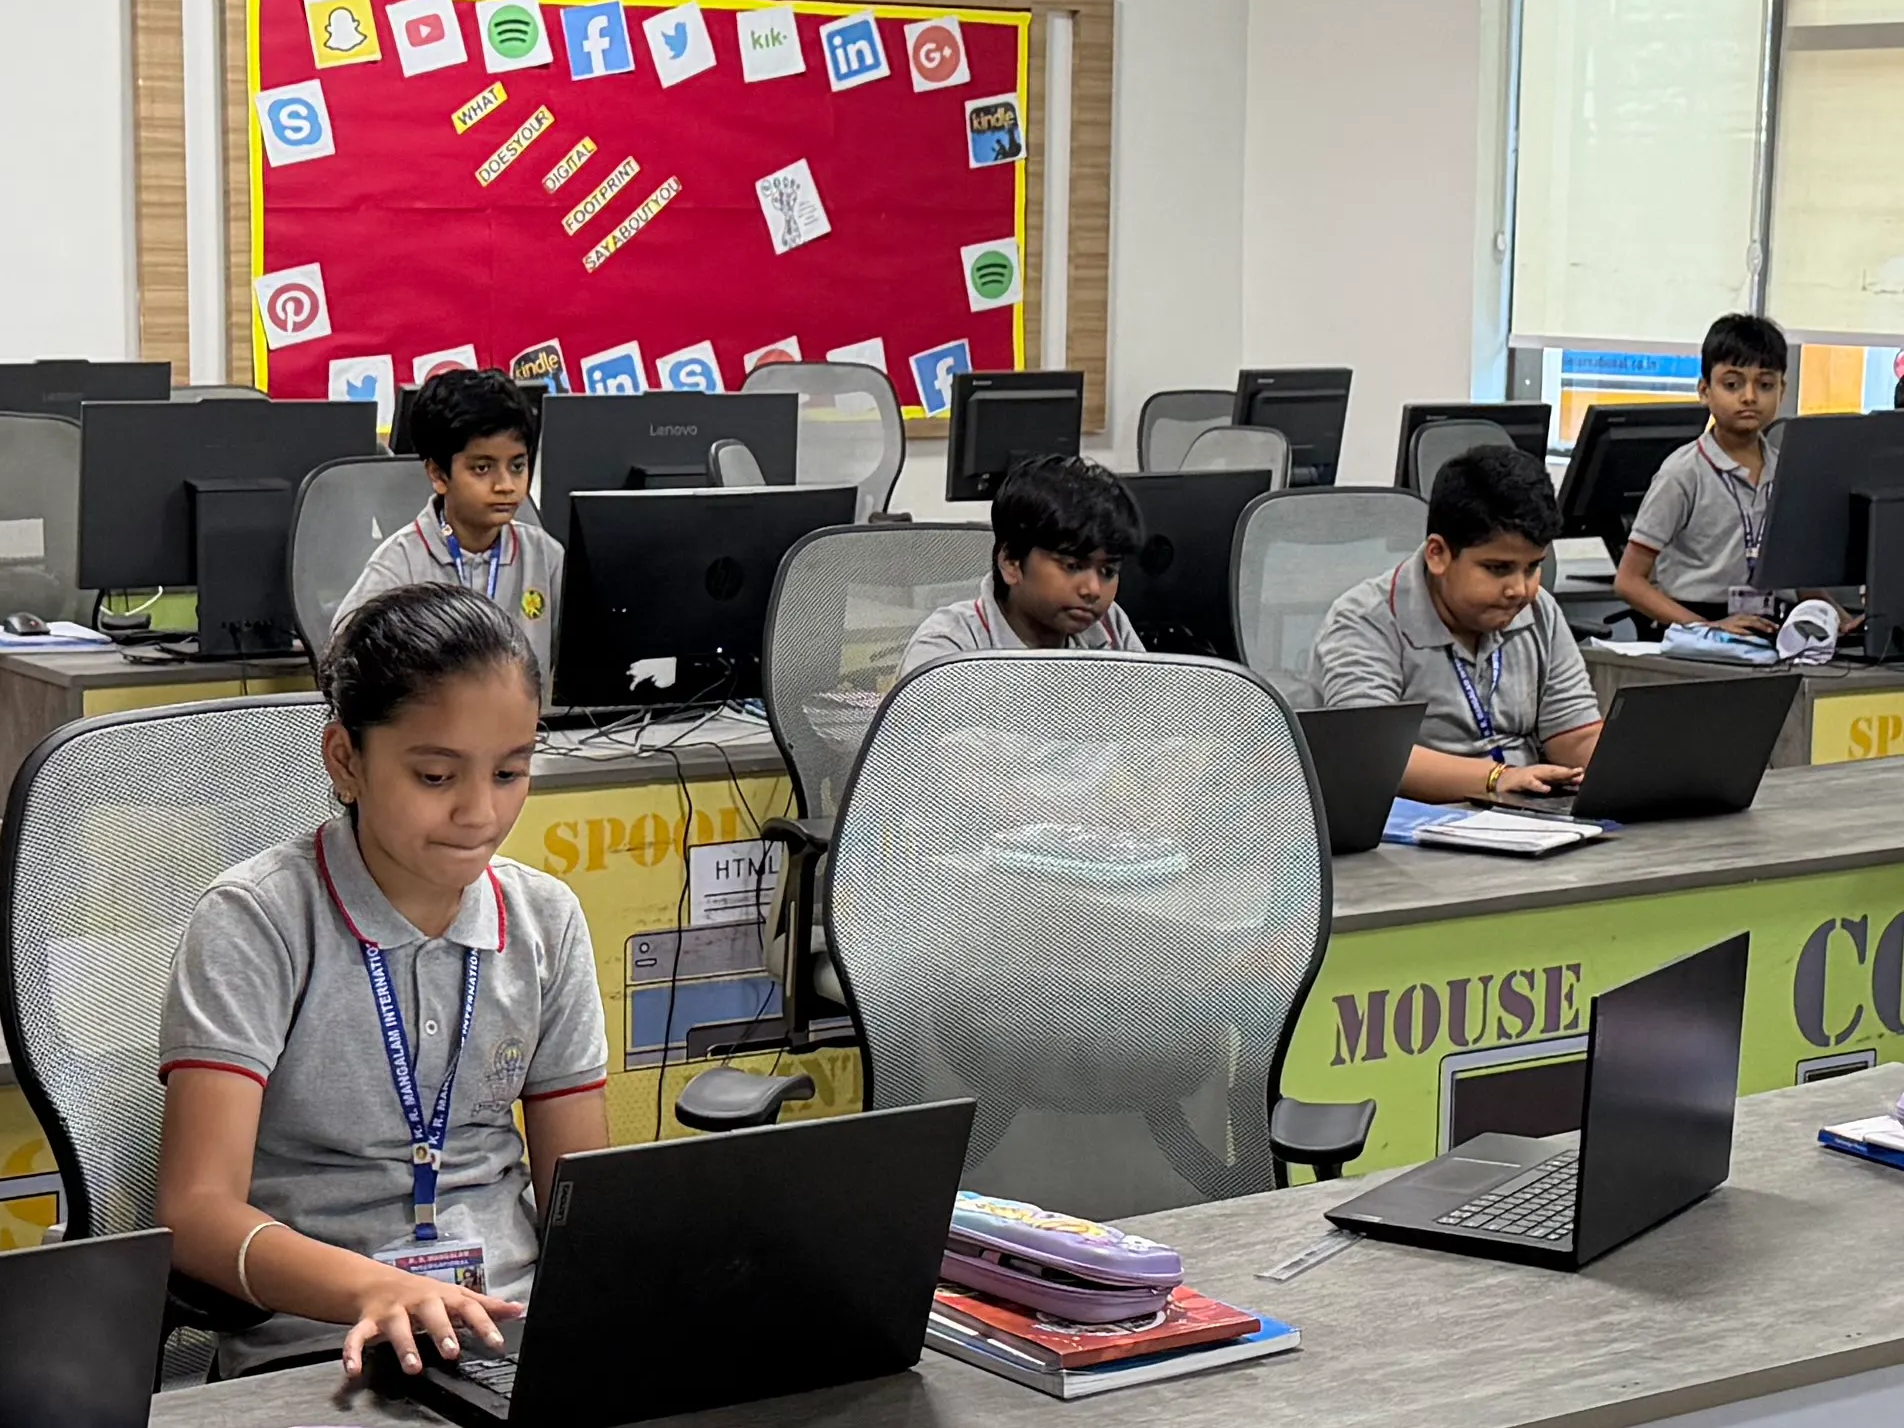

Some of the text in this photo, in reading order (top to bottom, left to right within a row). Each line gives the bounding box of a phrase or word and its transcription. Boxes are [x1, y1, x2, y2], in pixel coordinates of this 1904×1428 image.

[832, 35, 874, 75] in
[456, 87, 501, 127] WHAT
[970, 108, 1014, 131] kindle
[543, 143, 595, 193] DIGITAL
[565, 159, 637, 232] FOOTPRINT
[649, 423, 698, 437] Lenovo
[366, 943, 398, 1026] INTERNATIO
[1331, 963, 1582, 1066] MOUSE
[388, 1029, 416, 1106] MANGALAM
